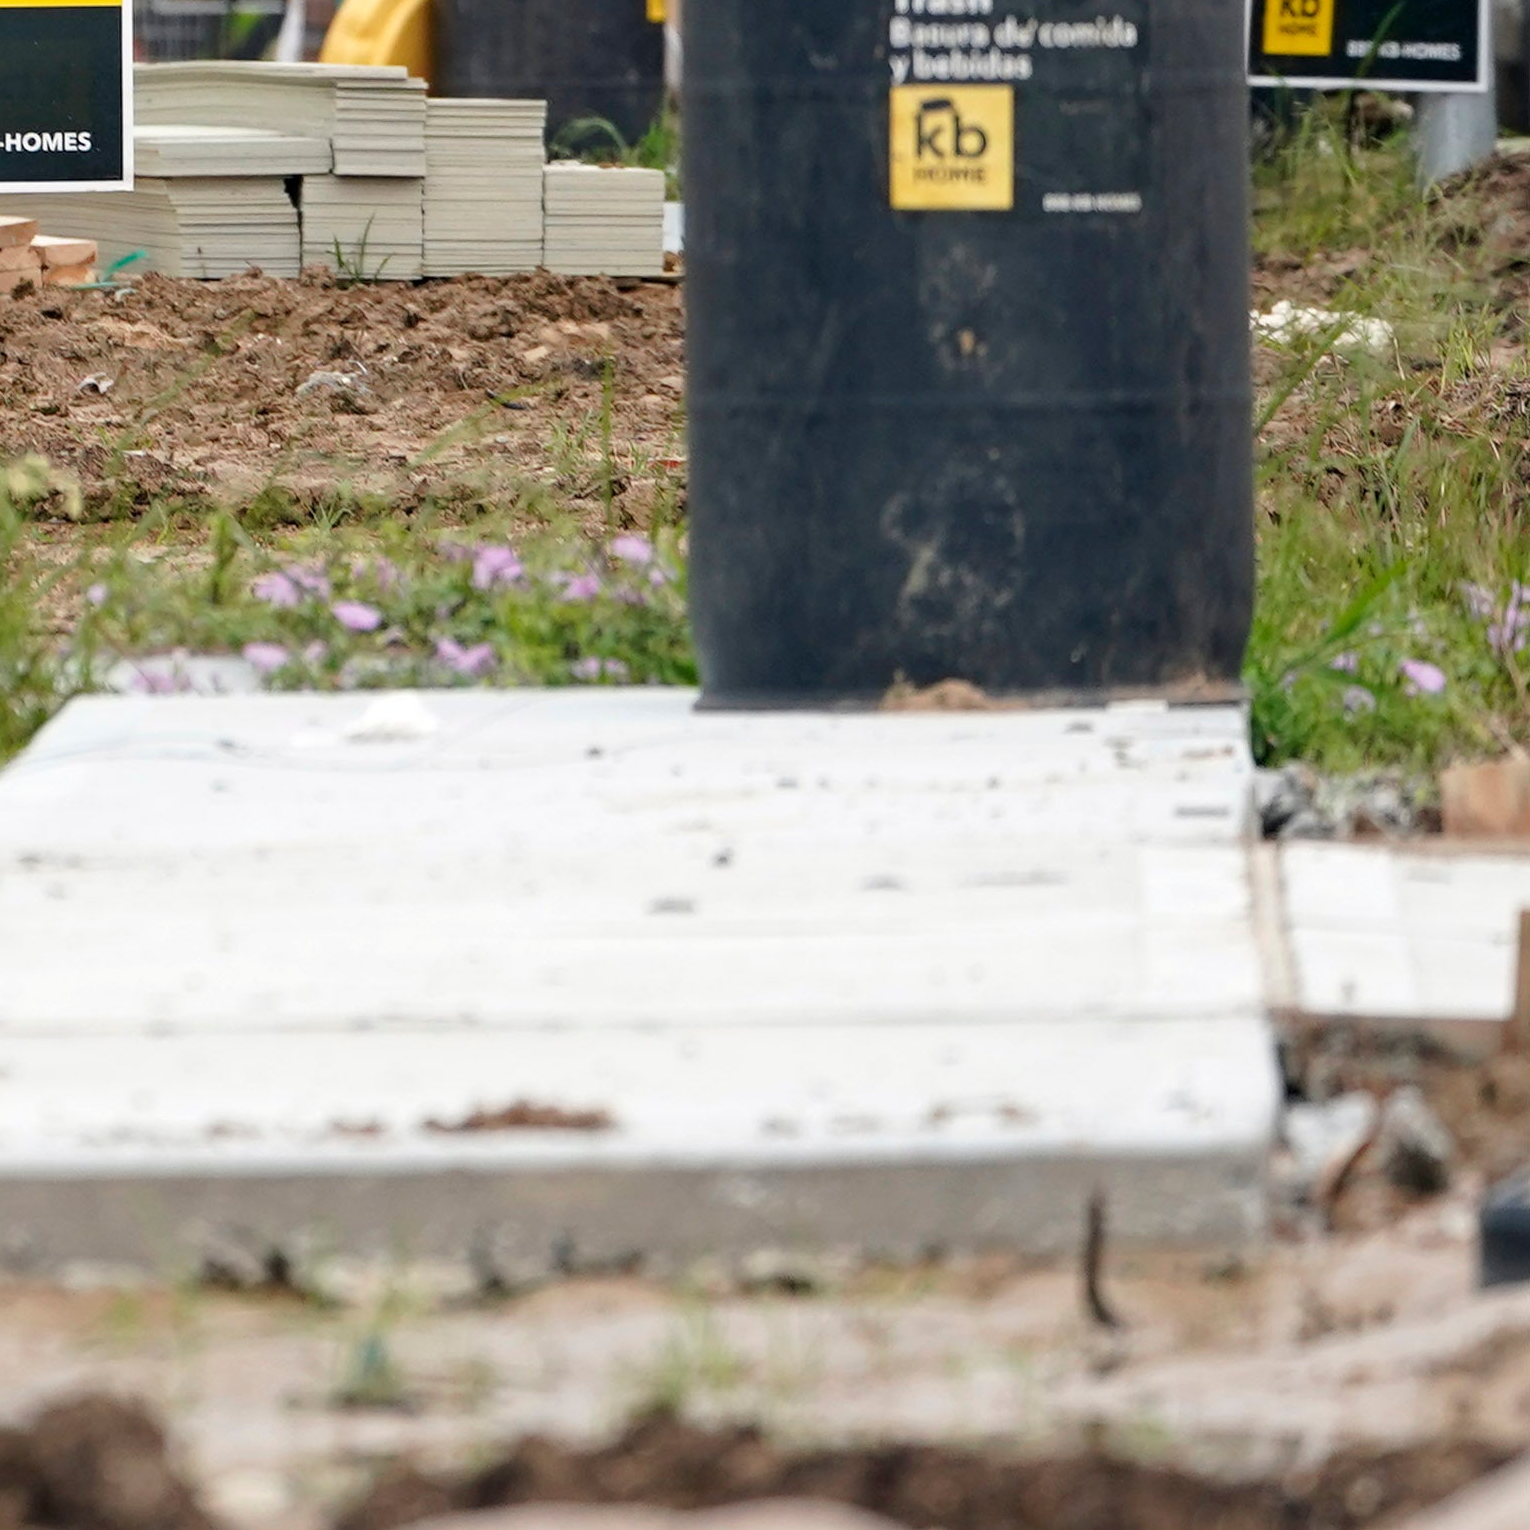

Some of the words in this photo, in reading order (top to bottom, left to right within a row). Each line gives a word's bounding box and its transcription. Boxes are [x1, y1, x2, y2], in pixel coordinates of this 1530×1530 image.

[890, 54, 911, 86] y
[913, 47, 1033, 80] bebidas
[915, 111, 987, 158] kb
